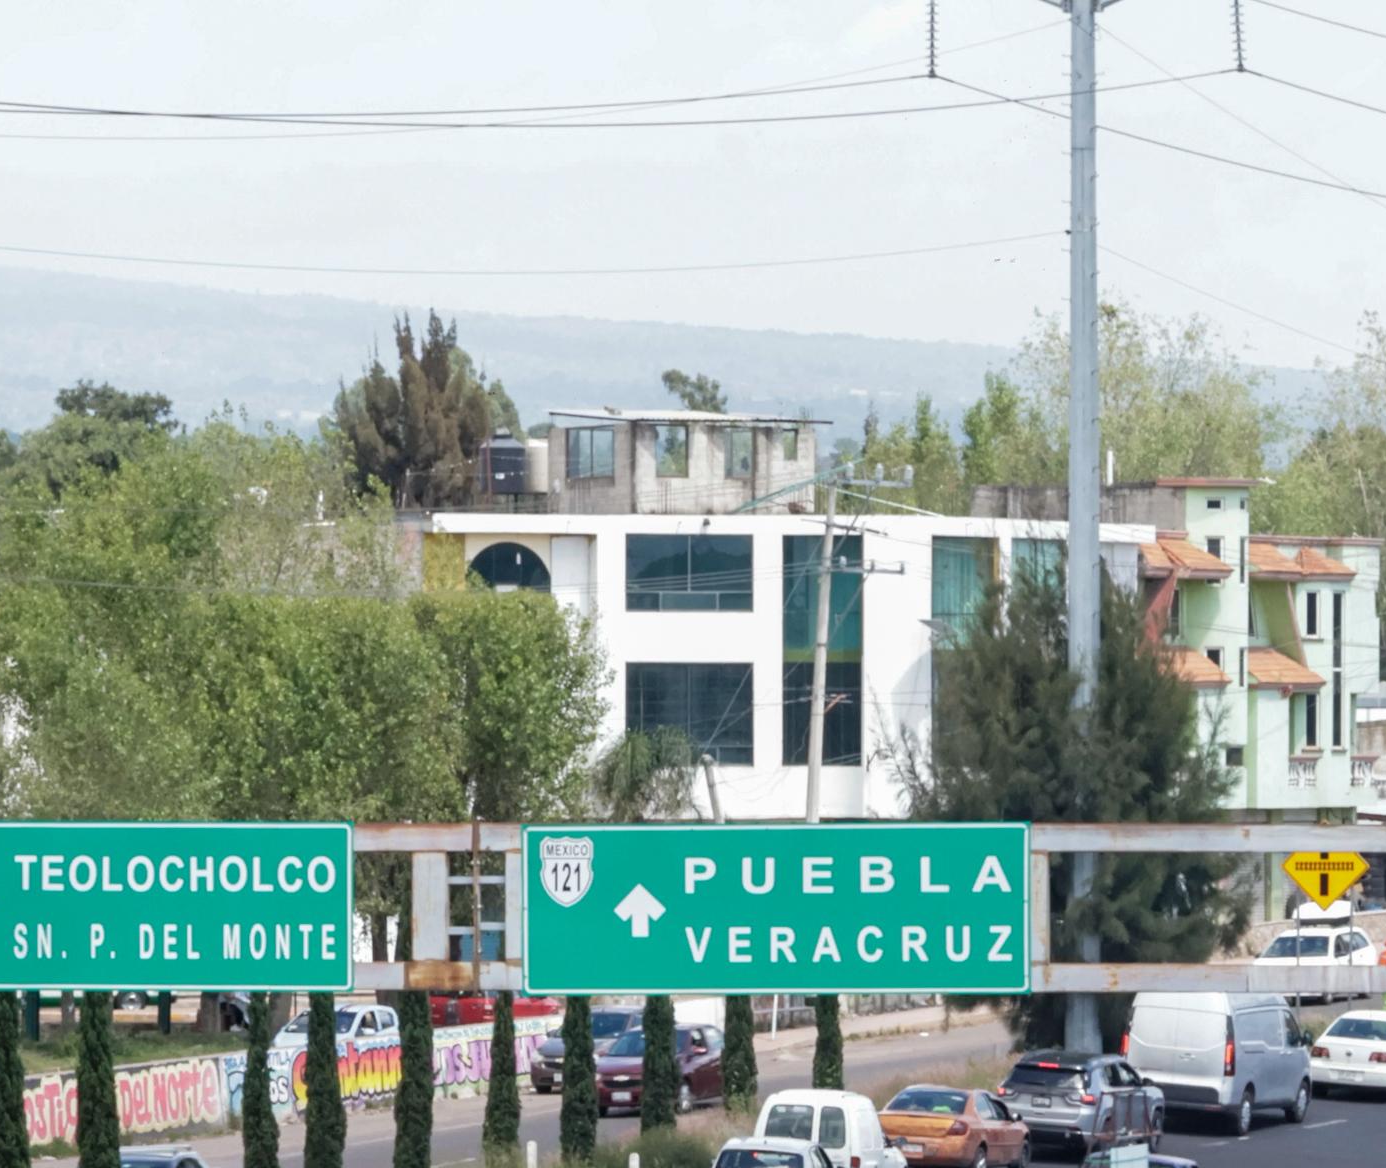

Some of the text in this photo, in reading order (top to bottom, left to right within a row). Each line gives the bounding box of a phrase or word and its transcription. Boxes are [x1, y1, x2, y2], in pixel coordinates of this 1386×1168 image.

[546, 844, 589, 856] MEXICO
[14, 855, 336, 892] TEOLOCHOLCO
[551, 862, 581, 892] 121
[684, 856, 1012, 894] PUEBLA
[13, 923, 336, 960] SN. P. DEL MONTE
[685, 925, 1013, 963] VERACRUZ
